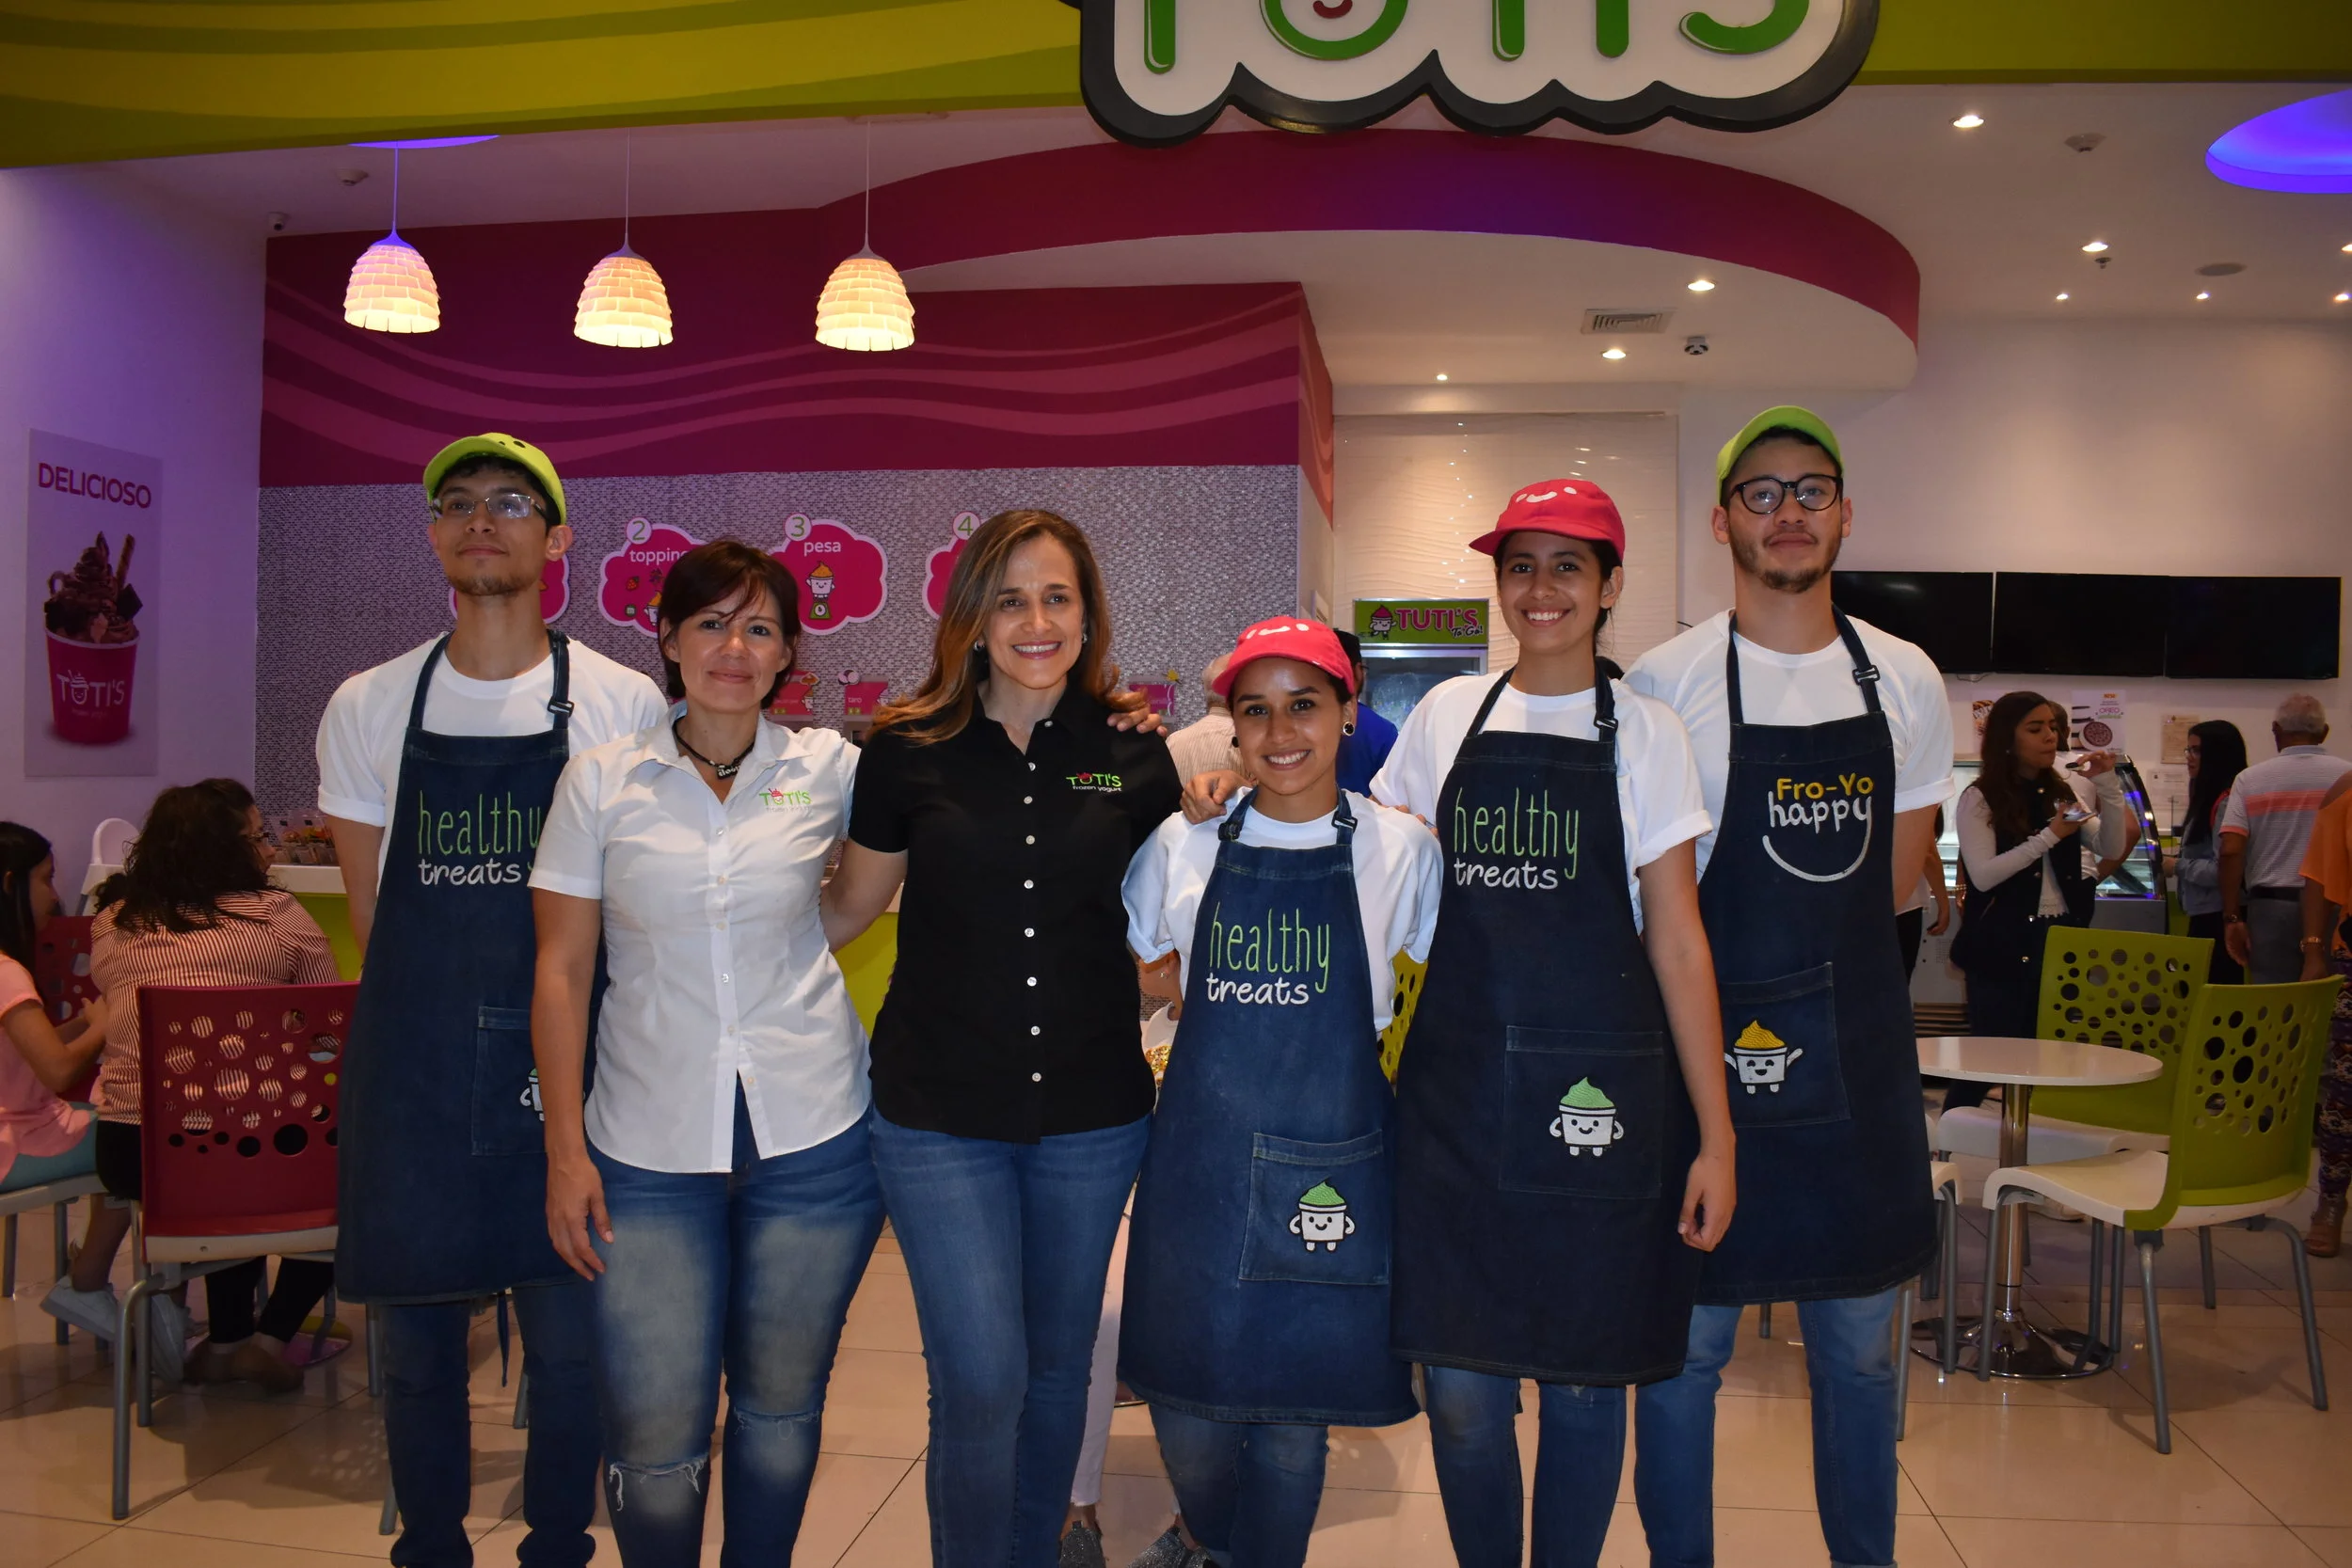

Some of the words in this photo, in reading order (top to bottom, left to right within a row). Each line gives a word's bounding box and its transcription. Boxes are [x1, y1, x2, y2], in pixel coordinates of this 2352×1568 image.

[39, 462, 151, 509] DELICIOSO
[632, 520, 645, 541] 2
[791, 516, 805, 537] 3
[958, 515, 974, 536] 4
[803, 541, 842, 557] pesa
[1395, 608, 1479, 630] TUTI'S
[1452, 627, 1462, 638] To
[1777, 772, 1874, 800] Fro-Yo
[418, 789, 541, 871] healthy
[1454, 786, 1579, 879] healthy
[418, 858, 522, 886] treats
[1454, 858, 1558, 890] treats
[1210, 901, 1330, 993] healthy
[1206, 972, 1310, 1006] treats
